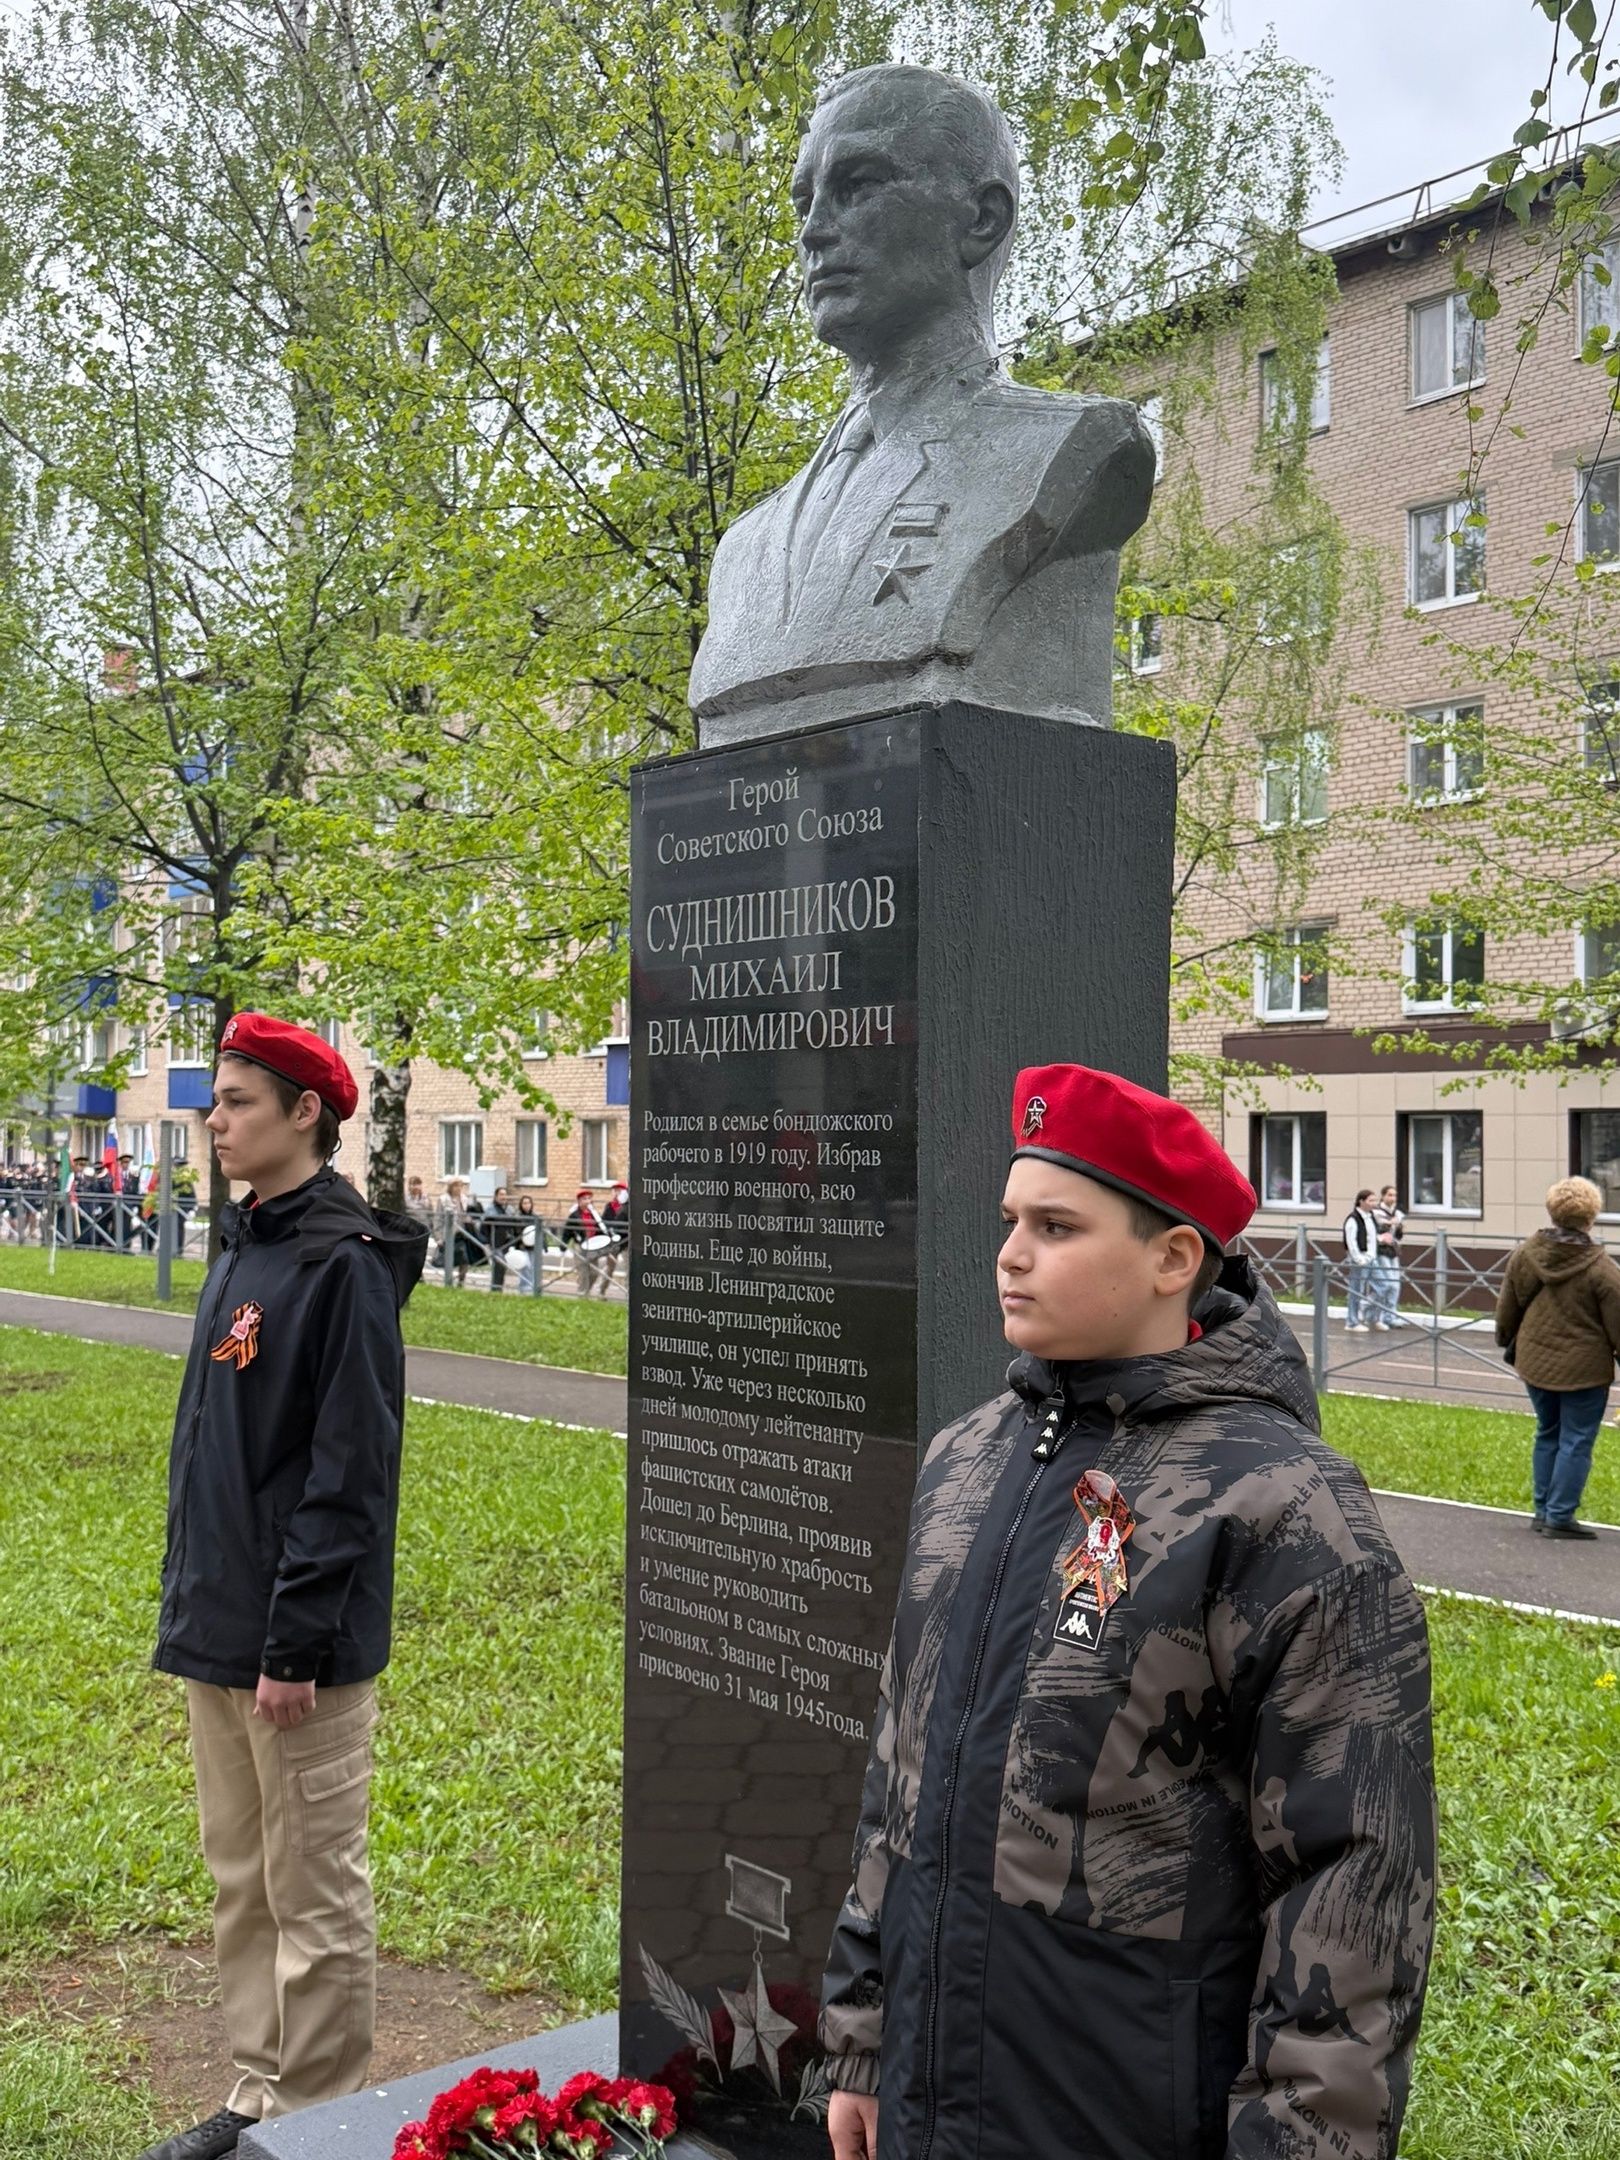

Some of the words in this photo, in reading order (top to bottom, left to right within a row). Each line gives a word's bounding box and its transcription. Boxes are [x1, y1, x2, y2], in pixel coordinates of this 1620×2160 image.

[728, 767, 800, 815] Герой
[658, 822, 788, 864] Советского
[797, 806, 883, 842] Союза
[647, 875, 895, 962] СУДНИШНИКОВ
[690, 951, 842, 1000] МИХАИЛ
[648, 1005, 895, 1063] ВЛАДИМИРОВИЧ
[644, 1111, 703, 1133] Родился
[709, 1119, 717, 1131] в
[722, 1118, 768, 1131] семье
[773, 1109, 893, 1134] бондюжского
[643, 1142, 709, 1168] рабочего
[715, 1151, 723, 1164] в
[730, 1142, 765, 1164] 1919
[771, 1149, 810, 1170] году.
[817, 1142, 881, 1172] Избрав
[642, 1174, 729, 1200] профессию
[734, 1182, 814, 1202] военного,
[821, 1186, 855, 1200] всю
[643, 1209, 680, 1225] свою
[685, 1212, 732, 1229] жизнь
[738, 1215, 813, 1233] посвятил
[820, 1219, 885, 1239] защите
[643, 1235, 703, 1260] Родины.
[709, 1239, 743, 1264] Еще
[747, 1247, 767, 1265] до
[773, 1245, 832, 1273] войны,
[643, 1271, 703, 1291] окончив
[708, 1271, 835, 1305] Ленинградское
[642, 1303, 841, 1339] зенитно-артиллерийское
[642, 1334, 713, 1361] училище,
[719, 1343, 737, 1360] он
[742, 1346, 789, 1368] успел
[795, 1352, 868, 1378] принять
[642, 1365, 685, 1387] взвод.
[691, 1366, 723, 1392] Уже
[728, 1378, 772, 1403] через
[778, 1384, 865, 1413] несколько
[642, 1396, 676, 1417] дней
[681, 1404, 759, 1435] молодому
[764, 1414, 863, 1453] лейтенанту
[642, 1429, 717, 1456] пришлось
[723, 1443, 798, 1472] отражать
[803, 1458, 852, 1482] атаки
[642, 1456, 735, 1494] фашистских
[741, 1479, 833, 1514] самолётов.
[1308, 1474, 1325, 1492] IN
[641, 1487, 691, 1518] Дошел
[696, 1505, 714, 1523] до
[721, 1503, 792, 1543] Берлина,
[799, 1526, 872, 1558] проявив
[641, 1524, 775, 1572] исключительную
[781, 1555, 872, 1594] храбрость
[641, 1555, 650, 1573] и
[653, 1560, 709, 1588] умение
[714, 1576, 808, 1614] руководить
[640, 1583, 728, 1627] батальоном
[734, 1614, 743, 1630] в
[748, 1617, 801, 1647] самых
[1155, 1624, 1201, 1653] MOTIO
[639, 1619, 713, 1656] условиях.
[719, 1637, 775, 1674] Звание
[781, 1656, 830, 1692] Героя
[639, 1652, 720, 1692] присвоено
[725, 1673, 741, 1699] 31
[749, 1685, 779, 1710] мая
[786, 1692, 869, 1740] 1945года.
[1001, 1793, 1059, 1849] MOTION
[1141, 1794, 1156, 1808] IN
[1282, 2078, 1329, 2136] MOTION
[1330, 2131, 1350, 2156] IN
